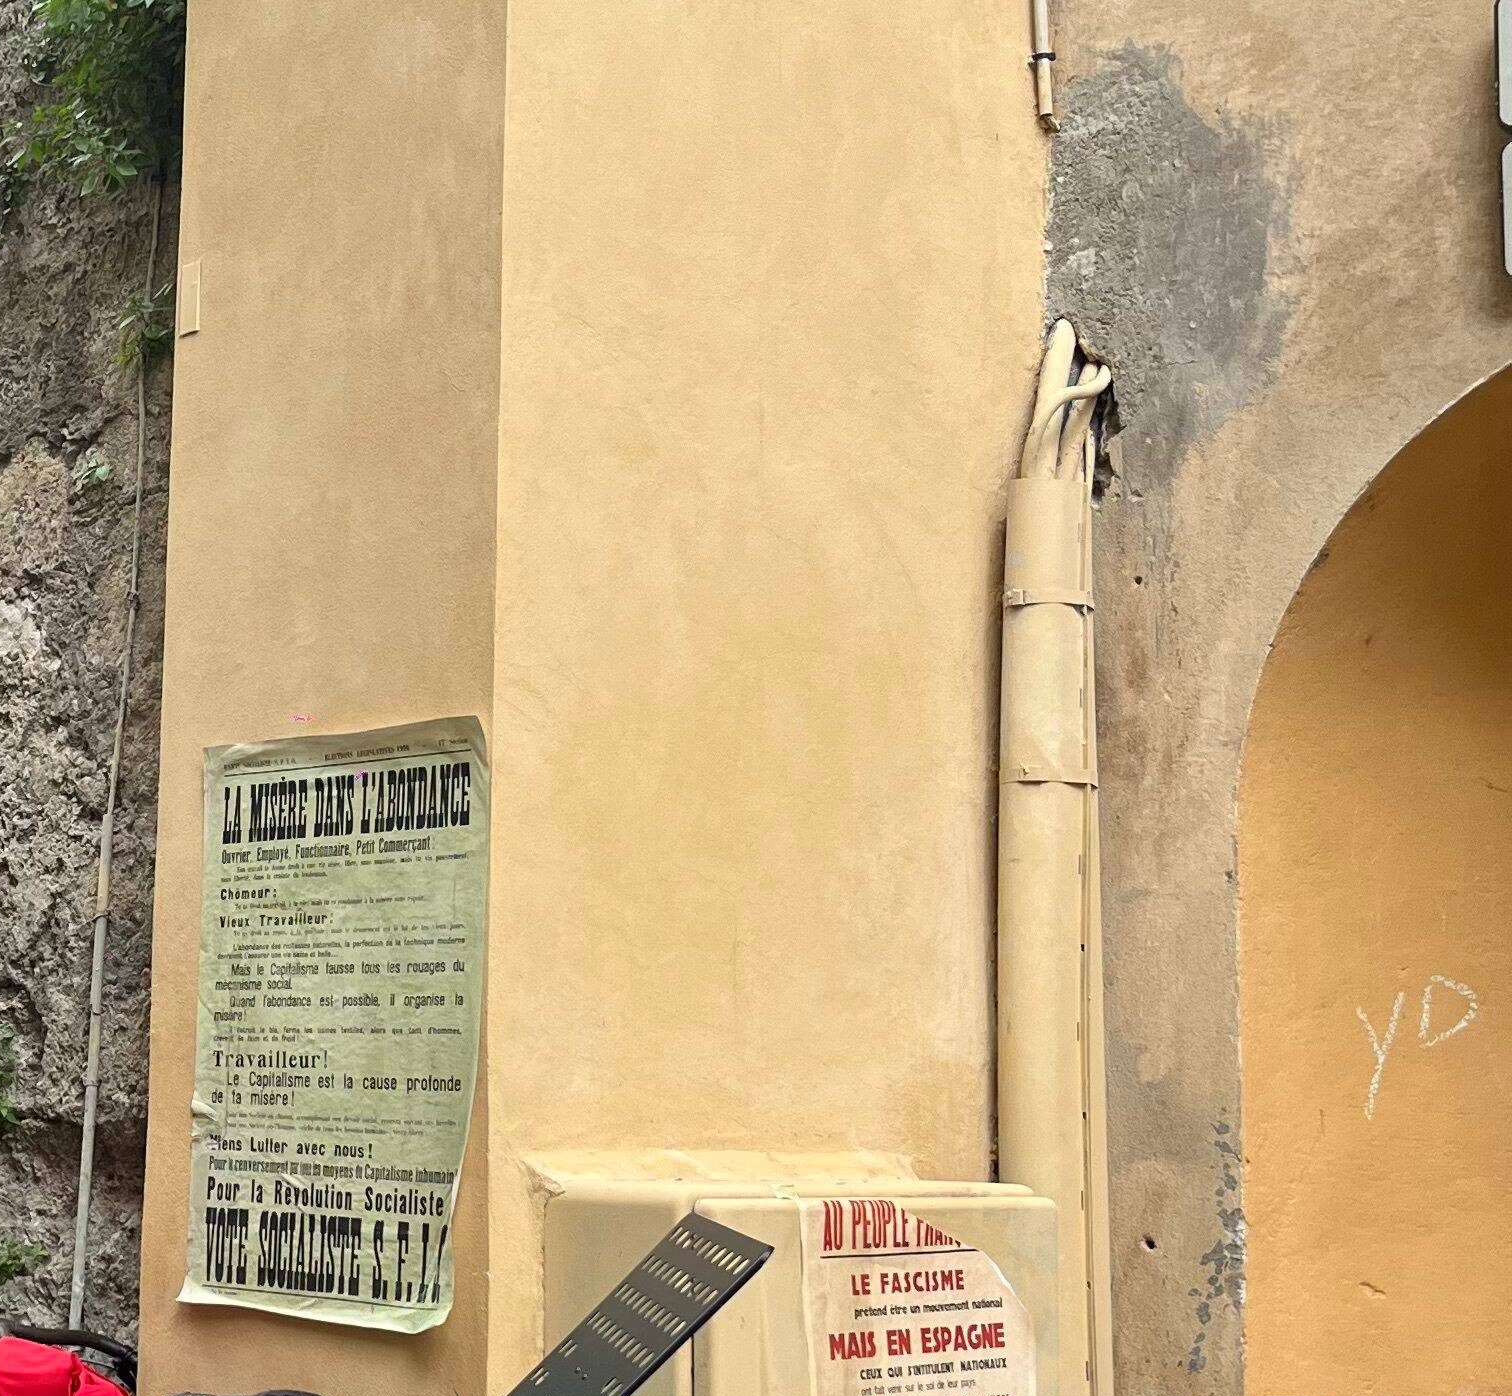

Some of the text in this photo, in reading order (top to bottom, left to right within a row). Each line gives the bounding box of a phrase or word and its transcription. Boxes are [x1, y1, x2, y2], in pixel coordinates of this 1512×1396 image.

[222, 762, 471, 845] LA MISÈRE DANS L'ABONDANCE
[356, 840, 376, 856] Petit
[220, 915, 250, 928] Vieux
[231, 959, 465, 979] Mais le Capitalisme fausse tous les rouages du
[230, 995, 256, 1008] Quand
[263, 995, 312, 1008] l'abondance
[390, 993, 396, 1007] il
[404, 993, 446, 1010] organise
[455, 992, 464, 1006] la
[227, 1071, 462, 1095] Le Capitalisme est la cause profonde
[211, 1088, 224, 1104] de
[232, 1090, 242, 1105] la
[250, 1136, 288, 1154] Lutter
[296, 1142, 326, 1156] avec
[209, 1155, 227, 1171] Pour
[364, 1164, 414, 1183] Capitalisme
[207, 1176, 240, 1203] Pour
[251, 1179, 264, 1204] la
[365, 1186, 445, 1217] Socialiste
[823, 1200, 844, 1252] AU
[849, 1200, 910, 1250] PEUPLE
[206, 1207, 250, 1286] VOTE
[258, 1210, 363, 1297] SOCIALISTE
[851, 1269, 965, 1296] LE FASCISME
[910, 1305, 921, 1314] un
[923, 1300, 970, 1314] mouvement
[972, 1297, 1003, 1310] national
[828, 1322, 1006, 1361] MAIS EN ESPAGNE
[860, 1358, 1008, 1381] CEUX QUI S'INTITULENT NATIONAUX
